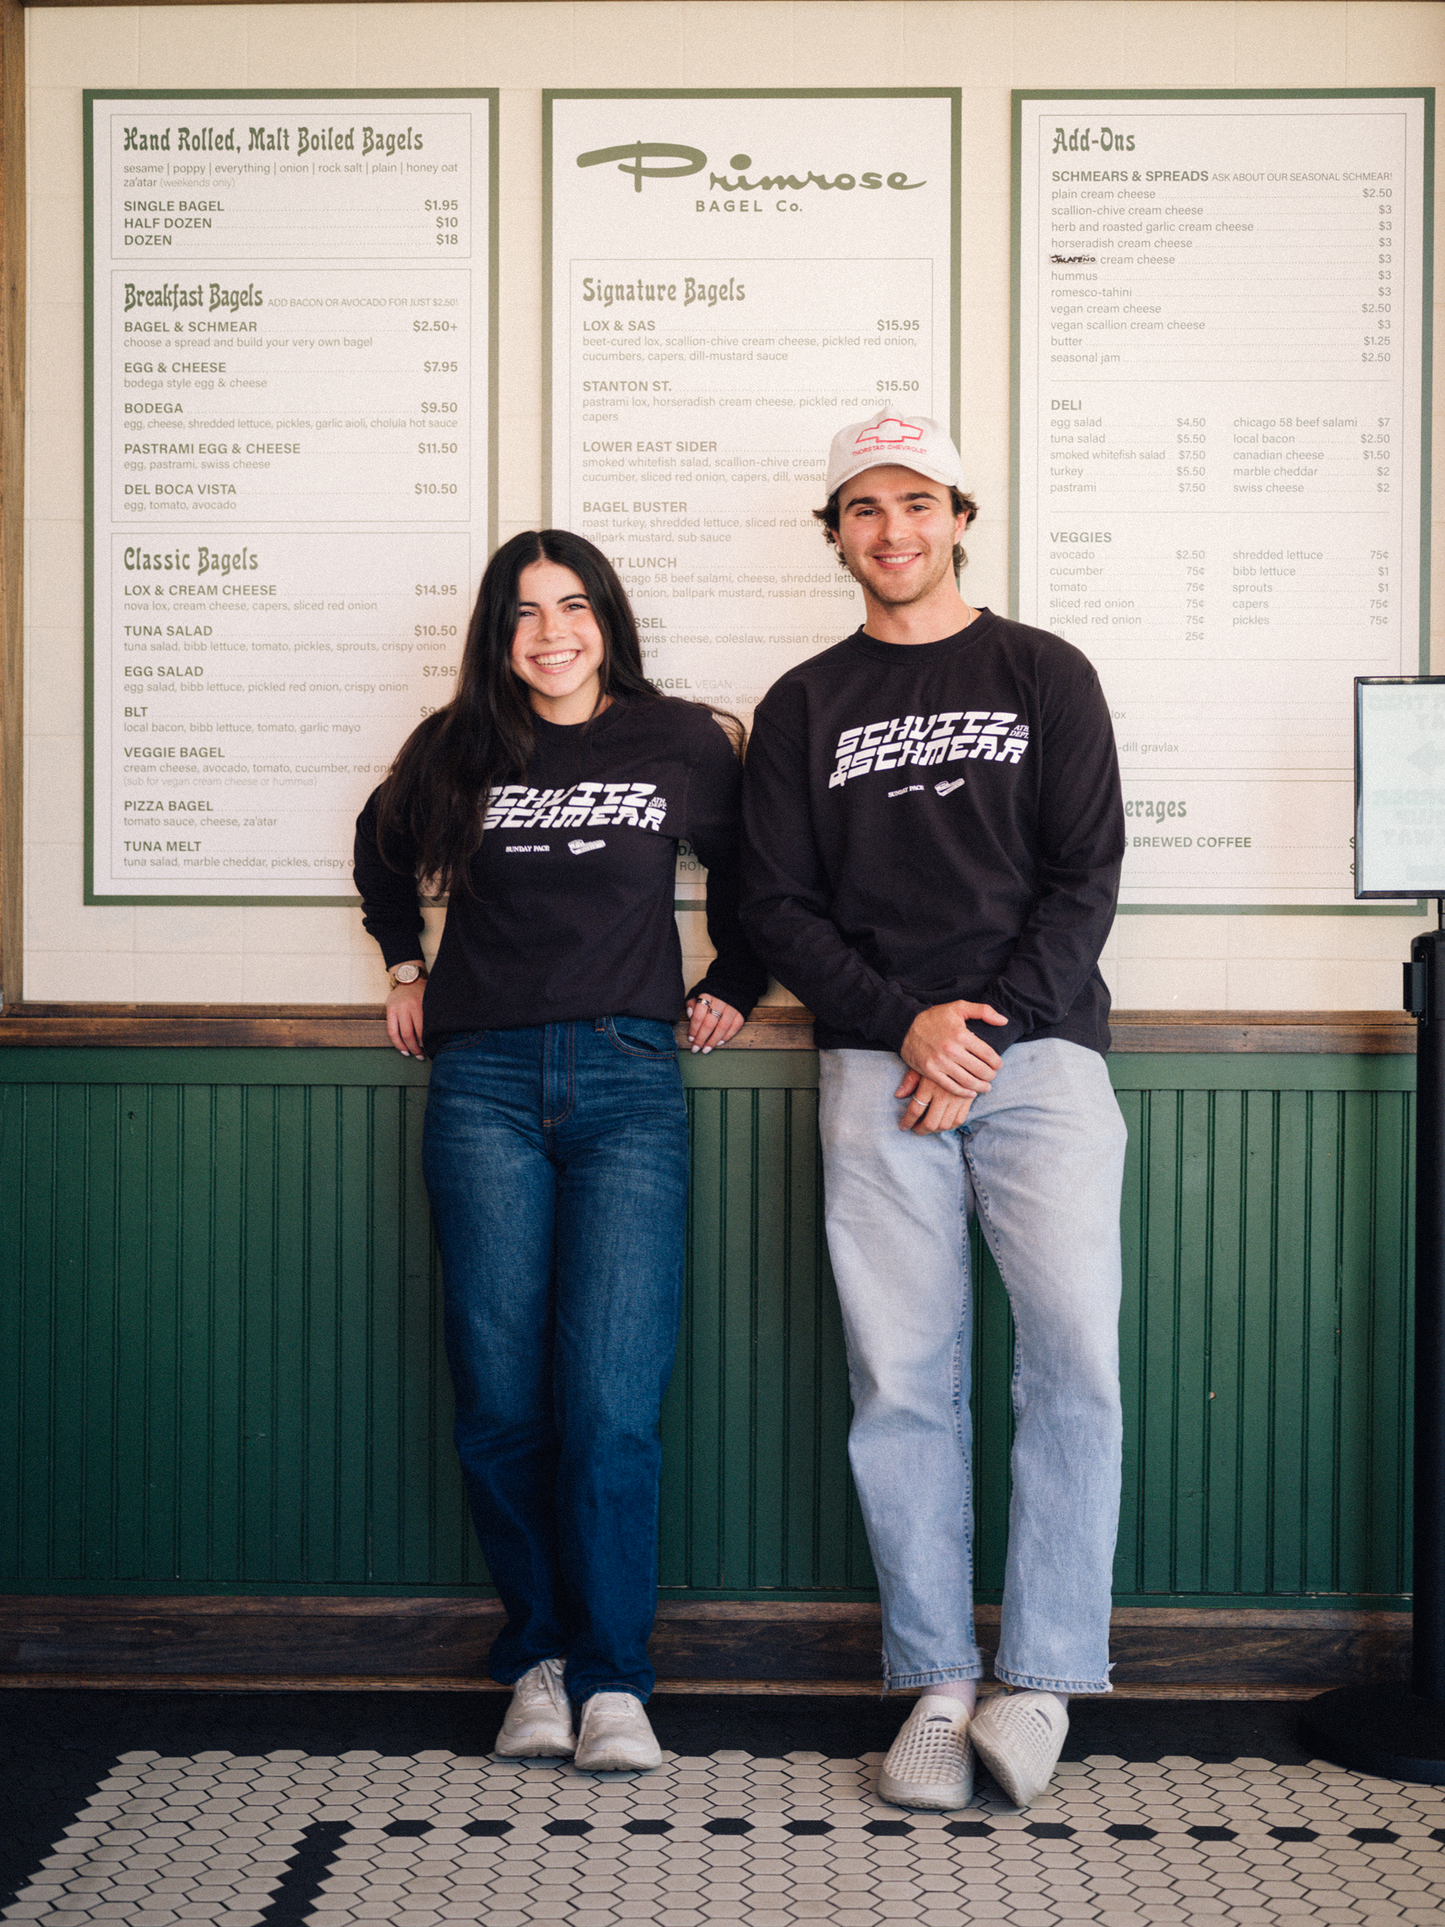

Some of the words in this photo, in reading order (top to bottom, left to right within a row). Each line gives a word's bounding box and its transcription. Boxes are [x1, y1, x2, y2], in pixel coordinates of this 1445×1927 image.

[124, 127, 170, 151] Hand
[178, 127, 240, 152] Rolled,
[248, 127, 289, 151] Malt
[297, 127, 354, 155] Boiled
[362, 127, 423, 156] Bagels
[1053, 128, 1135, 153] Add-Ons
[124, 165, 164, 173] sesame
[173, 165, 205, 176] poppy
[215, 162, 270, 176] everything
[280, 164, 309, 173] onion
[318, 162, 341, 173] rock
[344, 162, 362, 173] salt
[372, 162, 397, 176] plain
[407, 162, 438, 176] honey
[441, 163, 458, 173] oat
[576, 140, 927, 192] Primrose
[1052, 171, 1128, 181] SCHMEARS
[1132, 171, 1141, 181] &
[1146, 171, 1208, 181] SPREADS
[1212, 173, 1230, 181] ASK
[1233, 173, 1264, 181] ABOUT
[1267, 173, 1287, 181] OUR
[1290, 173, 1338, 181] SEASONAL
[1343, 173, 1392, 181] SCHMEAR!
[1052, 189, 1077, 202] plain
[1081, 191, 1114, 199] cream
[1117, 189, 1156, 199] cheese
[1363, 188, 1392, 198] $2.50
[124, 201, 174, 211] SINGLE
[179, 201, 224, 211] BAGEL
[425, 200, 458, 210] $1.95
[695, 200, 763, 212] BAGEL
[776, 200, 803, 212] Co.
[125, 218, 159, 228] HALF
[164, 218, 211, 228] DOZEN
[436, 217, 458, 228] $10
[125, 235, 172, 245] DOZEN
[436, 234, 458, 245] $18
[1100, 257, 1133, 265] cream
[1137, 255, 1175, 265] cheese
[1379, 254, 1391, 264] $3
[1051, 271, 1098, 281] hummus
[1378, 270, 1391, 280] $3
[583, 278, 676, 307] Signature
[684, 278, 745, 307] Bagels
[1051, 287, 1133, 297] romesco-tahini
[1378, 287, 1391, 296] $3
[124, 284, 203, 311] Breakfast
[209, 284, 263, 312] Bagels
[125, 322, 169, 332] BAGEL
[174, 322, 183, 332] &
[189, 322, 257, 332] SCHMEAR
[413, 321, 458, 331] $2.50+
[583, 321, 609, 331] LOX
[614, 321, 623, 331] &
[628, 320, 655, 331] SAS
[877, 320, 919, 330] $15.95
[1051, 336, 1083, 346] butter
[1364, 336, 1390, 346] $1.25
[1051, 353, 1098, 363] seasonal
[1101, 353, 1120, 366] jam
[1361, 353, 1391, 362] $2.50
[125, 362, 153, 373] EGG
[158, 363, 166, 373] &
[172, 362, 226, 373] CHEESE
[424, 361, 458, 372] $7.95
[583, 381, 648, 391] STANTON
[653, 381, 671, 391] ST.
[877, 380, 919, 391] $15.50
[125, 403, 183, 413] BODEGA
[421, 402, 457, 413] $9.50
[1051, 400, 1082, 410] DELI
[125, 444, 194, 454] PASTRAMI
[199, 444, 227, 454] EGG
[232, 444, 241, 454] &
[246, 443, 300, 454] CHEESE
[418, 443, 457, 453] $11.50
[583, 441, 632, 452] LOWER
[637, 441, 672, 452] EAST
[676, 441, 717, 452] SIDER
[887, 445, 927, 455] CHEVROLET
[124, 461, 146, 472] egg,
[150, 459, 197, 472] pastrami,
[201, 459, 230, 469] swiss
[233, 459, 270, 469] cheese
[1050, 465, 1083, 478] turkey
[1177, 466, 1205, 476] $5.50
[125, 484, 150, 495] DEL
[155, 484, 193, 494] BOCA
[198, 484, 236, 494] VISTA
[415, 483, 457, 494] $10.50
[1050, 481, 1097, 494] pastrami
[1179, 483, 1205, 492] $7.50
[583, 502, 628, 512] BAGEL
[633, 502, 687, 512] BUSTER
[1050, 532, 1112, 542] VEGGIES
[124, 547, 190, 570] Classic
[198, 547, 258, 576] Bagels
[125, 585, 150, 595] LOX
[155, 586, 164, 595] &
[169, 585, 218, 595] CREAM
[222, 585, 276, 595] CHEESE
[415, 585, 457, 595] $14.95
[1050, 583, 1087, 592] tomato
[1187, 583, 1204, 592] 75¢
[1233, 581, 1275, 593] sprouts
[1378, 583, 1388, 593] $1
[1233, 615, 1272, 628] pickles
[1370, 616, 1388, 625] 75¢
[125, 626, 162, 636] TUNA
[167, 626, 212, 636] SALAD
[415, 625, 457, 636] $10.50
[125, 666, 153, 676] EGG
[158, 666, 203, 676] SALAD
[423, 666, 457, 677] $7.95
[125, 707, 147, 717] BLT
[835, 711, 1018, 759] SCHVITZ
[124, 747, 175, 757] VEGGIE
[180, 747, 224, 757] BAGEL
[124, 801, 164, 811] PIZZA
[169, 801, 213, 811] BAGEL
[1125, 800, 1187, 824] erages
[124, 841, 162, 851] TUNA
[167, 841, 201, 851] MELT
[1134, 837, 1192, 847] BREWED
[1197, 837, 1251, 847] COFFEE
[505, 845, 532, 853] SUNDAY
